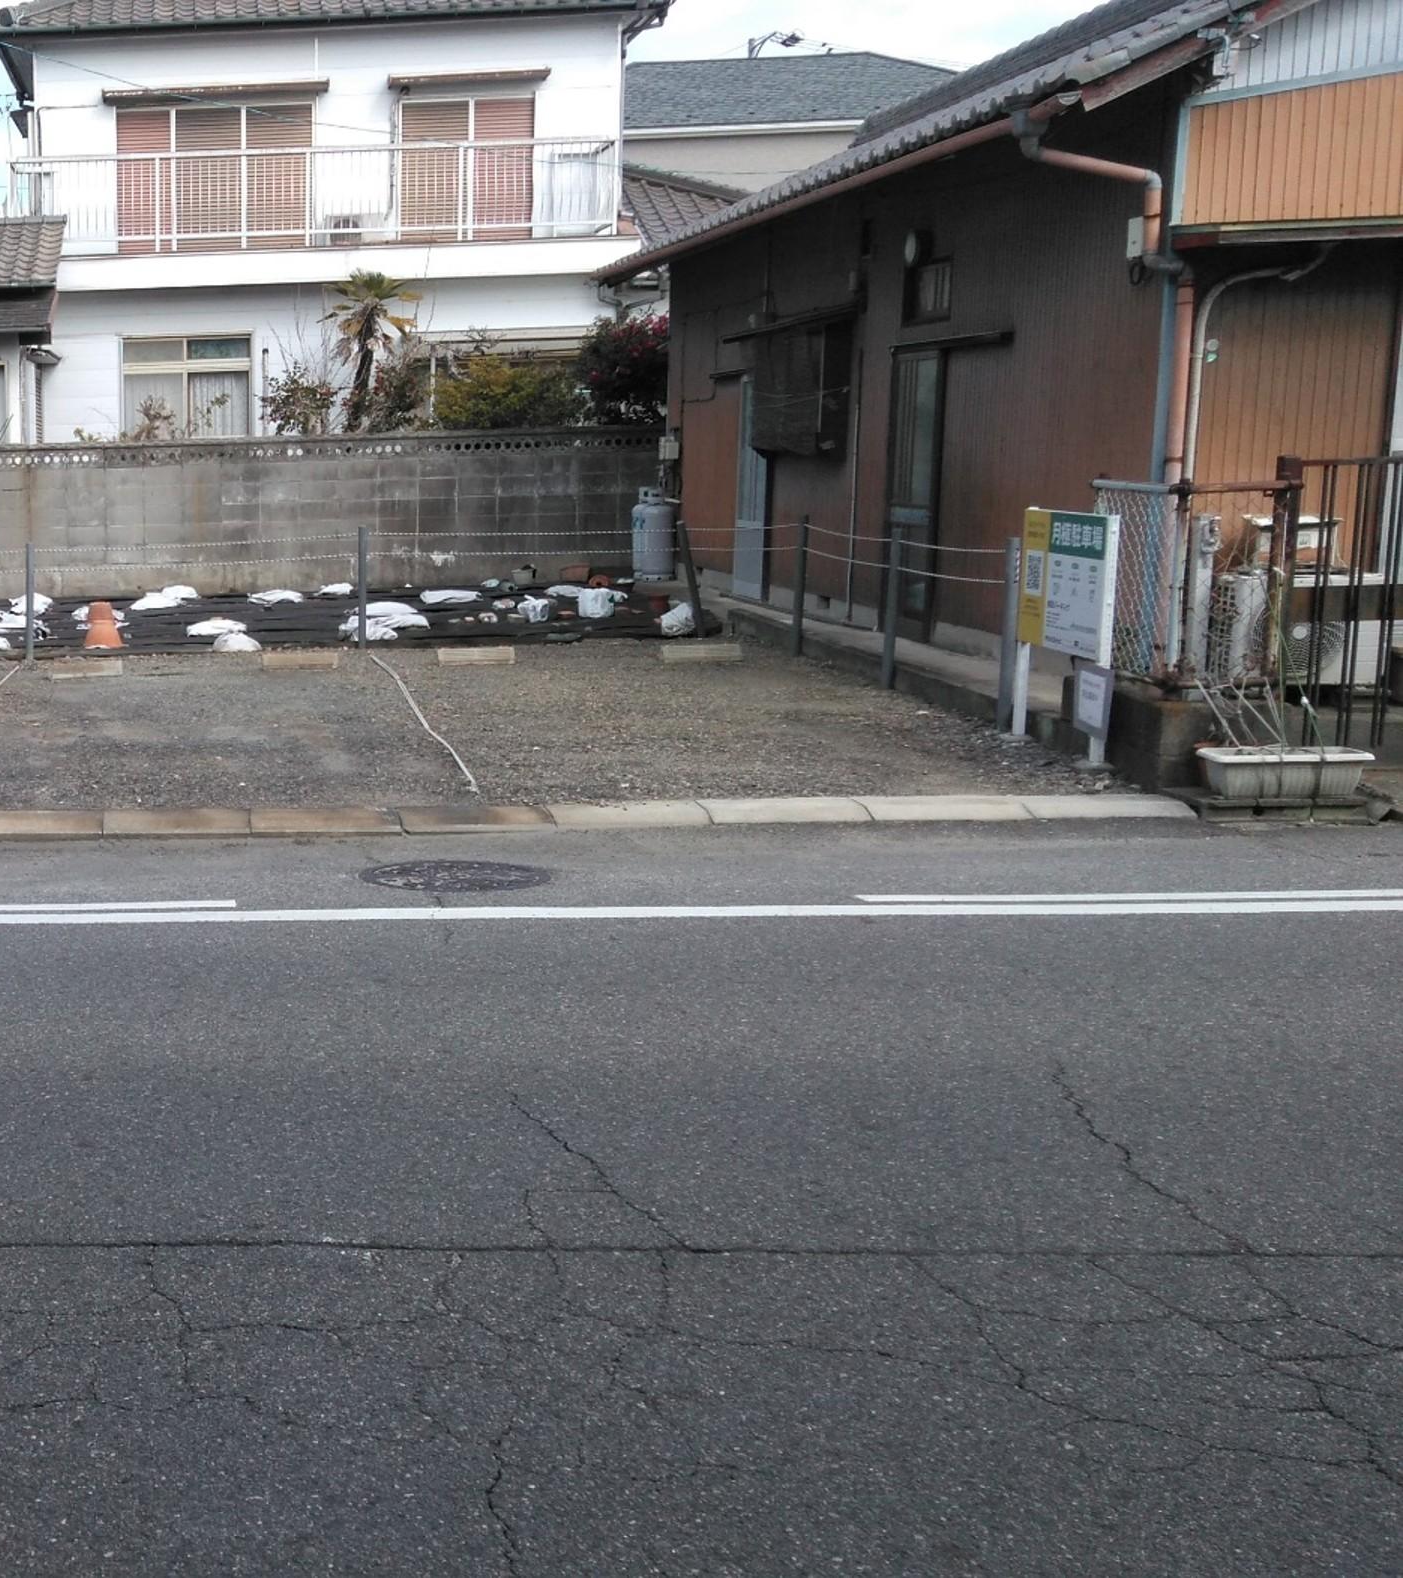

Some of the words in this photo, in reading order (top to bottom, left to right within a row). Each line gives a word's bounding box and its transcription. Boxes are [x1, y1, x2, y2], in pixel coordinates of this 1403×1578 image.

[1052, 522, 1103, 550] 月極駐車場
